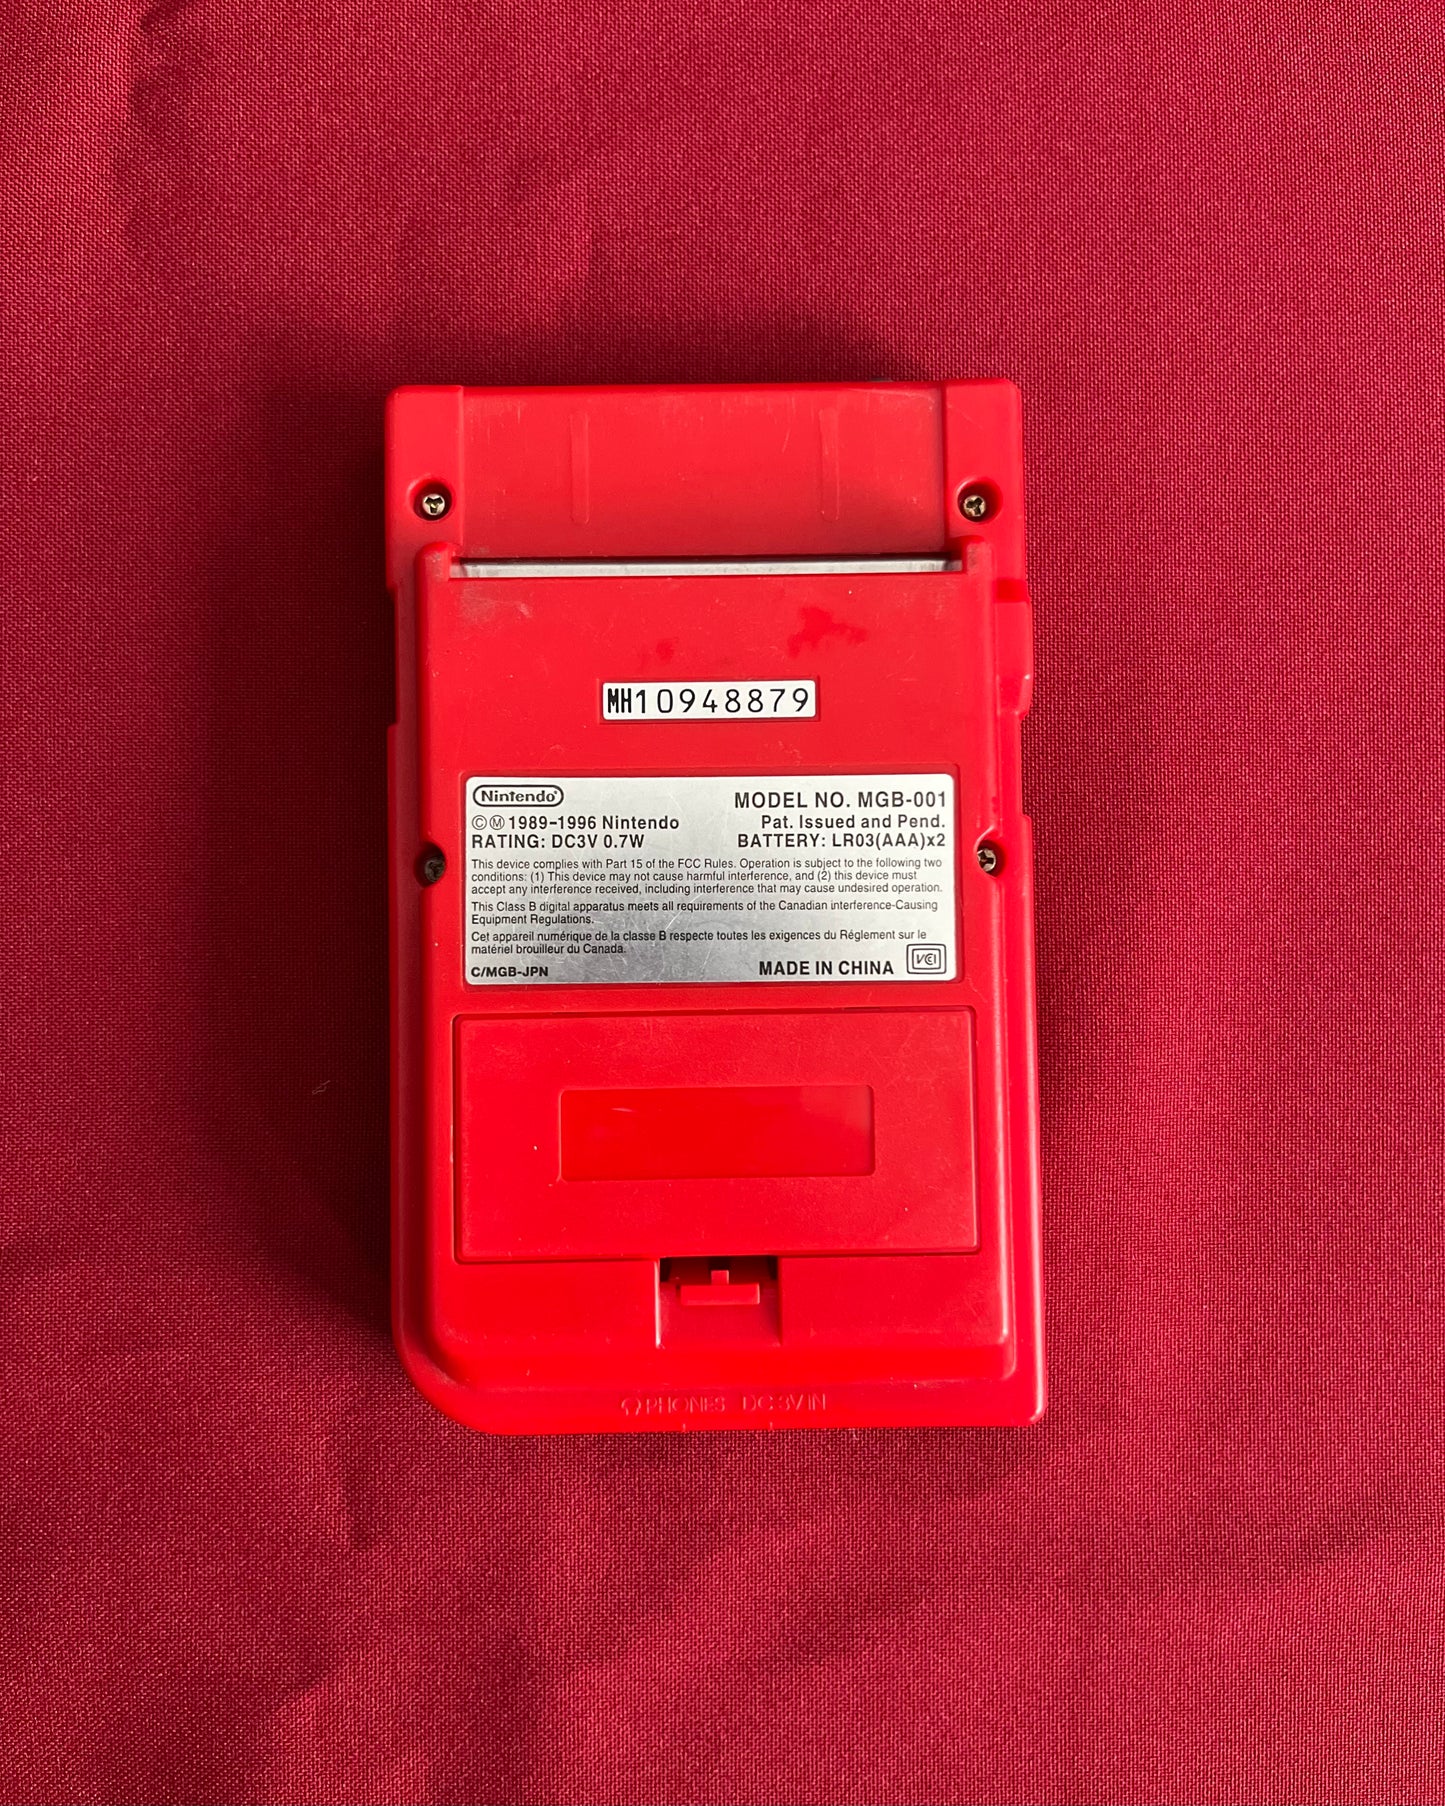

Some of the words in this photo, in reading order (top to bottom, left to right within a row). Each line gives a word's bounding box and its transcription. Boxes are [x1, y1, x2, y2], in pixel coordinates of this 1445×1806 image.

[607, 688, 809, 713] MH10948879
[481, 790, 555, 802] Nintendo
[735, 792, 808, 808] MODEL
[815, 792, 850, 808] NO.
[858, 791, 946, 807] MGB-001
[603, 816, 679, 829] Nintendo
[762, 815, 792, 829] Pat.
[800, 815, 855, 828] Issued
[861, 814, 891, 828] and
[898, 814, 945, 828] Pend.
[472, 835, 545, 848] RATING:
[552, 835, 597, 848] DC3V
[604, 834, 644, 848] 0.7W
[738, 834, 825, 847] BATTERY:
[472, 859, 493, 869] This
[497, 859, 530, 869] device
[534, 859, 578, 872] complies
[582, 859, 603, 869] with
[606, 859, 628, 869] Part
[631, 859, 642, 869] 15
[646, 859, 656, 869] of
[658, 859, 675, 869] the
[678, 859, 701, 869] FCC
[705, 859, 736, 869] Rules.
[740, 859, 790, 870] Operation
[793, 859, 801, 868] is
[805, 859, 840, 870] subject
[844, 859, 854, 868] to
[857, 859, 872, 867] the
[876, 858, 920, 870] following
[924, 859, 942, 867] two
[472, 872, 527, 882] conditions:
[530, 872, 544, 883] (1)
[548, 872, 569, 882] This
[573, 872, 606, 882] device
[609, 874, 630, 883] may
[634, 873, 650, 882] not
[686, 872, 725, 881] harmful
[728, 871, 792, 882] interference,
[795, 871, 814, 881] and
[817, 871, 831, 882] (2)
[834, 871, 852, 880] this
[855, 871, 889, 880] device
[892, 871, 917, 880] must
[472, 886, 506, 896] accept
[509, 887, 527, 896] any
[530, 885, 592, 894] interference
[595, 885, 641, 895] received,
[645, 885, 690, 895] including
[694, 884, 754, 893] interference
[757, 884, 776, 893] that
[780, 885, 801, 895] may
[804, 885, 835, 893] cause
[838, 883, 889, 893] undesired
[892, 883, 942, 895] operation.
[472, 902, 493, 912] This
[497, 902, 525, 912] Class
[529, 902, 536, 911] B
[540, 902, 570, 913] digital
[573, 902, 624, 913] apparatus
[628, 902, 658, 911] meets
[662, 902, 673, 910] all
[677, 902, 743, 912] requirements
[747, 901, 756, 910] of
[759, 901, 775, 910] the
[779, 901, 827, 910] Canadian
[831, 900, 937, 912] interference-Causing
[472, 915, 527, 926] Equipment
[530, 914, 594, 926] Regulations.
[472, 932, 490, 941] Cet
[493, 931, 534, 943] appareil
[538, 931, 592, 942] numérique
[595, 931, 608, 940] de
[611, 931, 620, 940] la
[623, 931, 655, 940] classe
[659, 931, 666, 940] B
[670, 933, 713, 942] respecte
[717, 931, 748, 940] toutes
[751, 931, 766, 940] les
[769, 931, 820, 942] exigences
[824, 931, 837, 940] du
[918, 930, 926, 939] le
[472, 944, 513, 954] matériel
[516, 944, 564, 954] brouilleur
[567, 944, 580, 953] du
[583, 944, 626, 953] Canada.
[471, 967, 548, 977] C/MGB-JPN
[759, 961, 809, 975] MADE
[815, 961, 832, 975] IN
[838, 960, 894, 975] CHINA
[646, 1396, 725, 1414] PHONES
